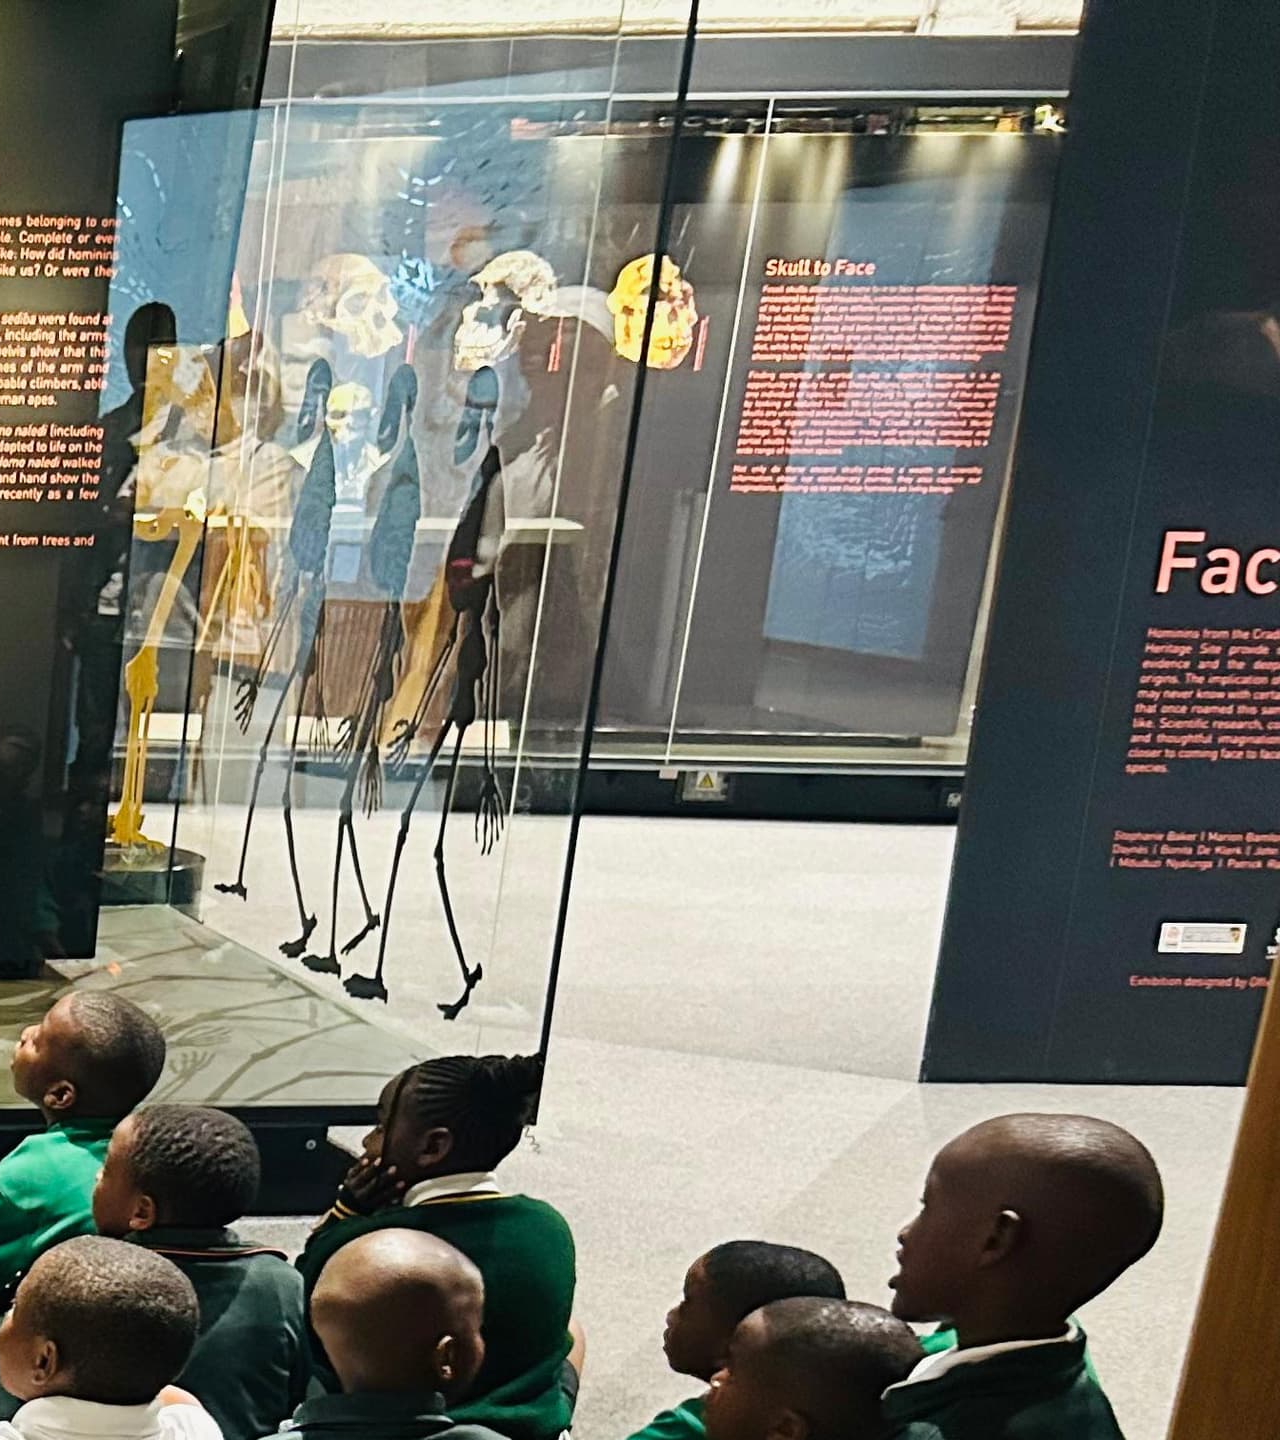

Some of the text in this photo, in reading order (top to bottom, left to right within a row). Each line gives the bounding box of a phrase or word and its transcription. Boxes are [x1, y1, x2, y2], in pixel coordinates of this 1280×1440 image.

[25, 214, 81, 230] belonging
[85, 215, 97, 227] to
[18, 230, 72, 246] Complete
[77, 233, 90, 243] or
[19, 246, 45, 259] How
[47, 247, 65, 259] did
[43, 263, 58, 276] Or
[62, 266, 89, 276] were
[765, 258, 877, 277] Skull to Face
[37, 314, 66, 324] were
[67, 312, 100, 324] found
[4, 328, 55, 343] including
[58, 328, 76, 340] the
[29, 344, 60, 356] show
[63, 344, 85, 356] that
[20, 360, 33, 372] of
[36, 360, 55, 372] the
[59, 363, 83, 372] arm
[12, 533, 38, 545] from
[42, 533, 70, 545] trees
[72, 533, 94, 545] and
